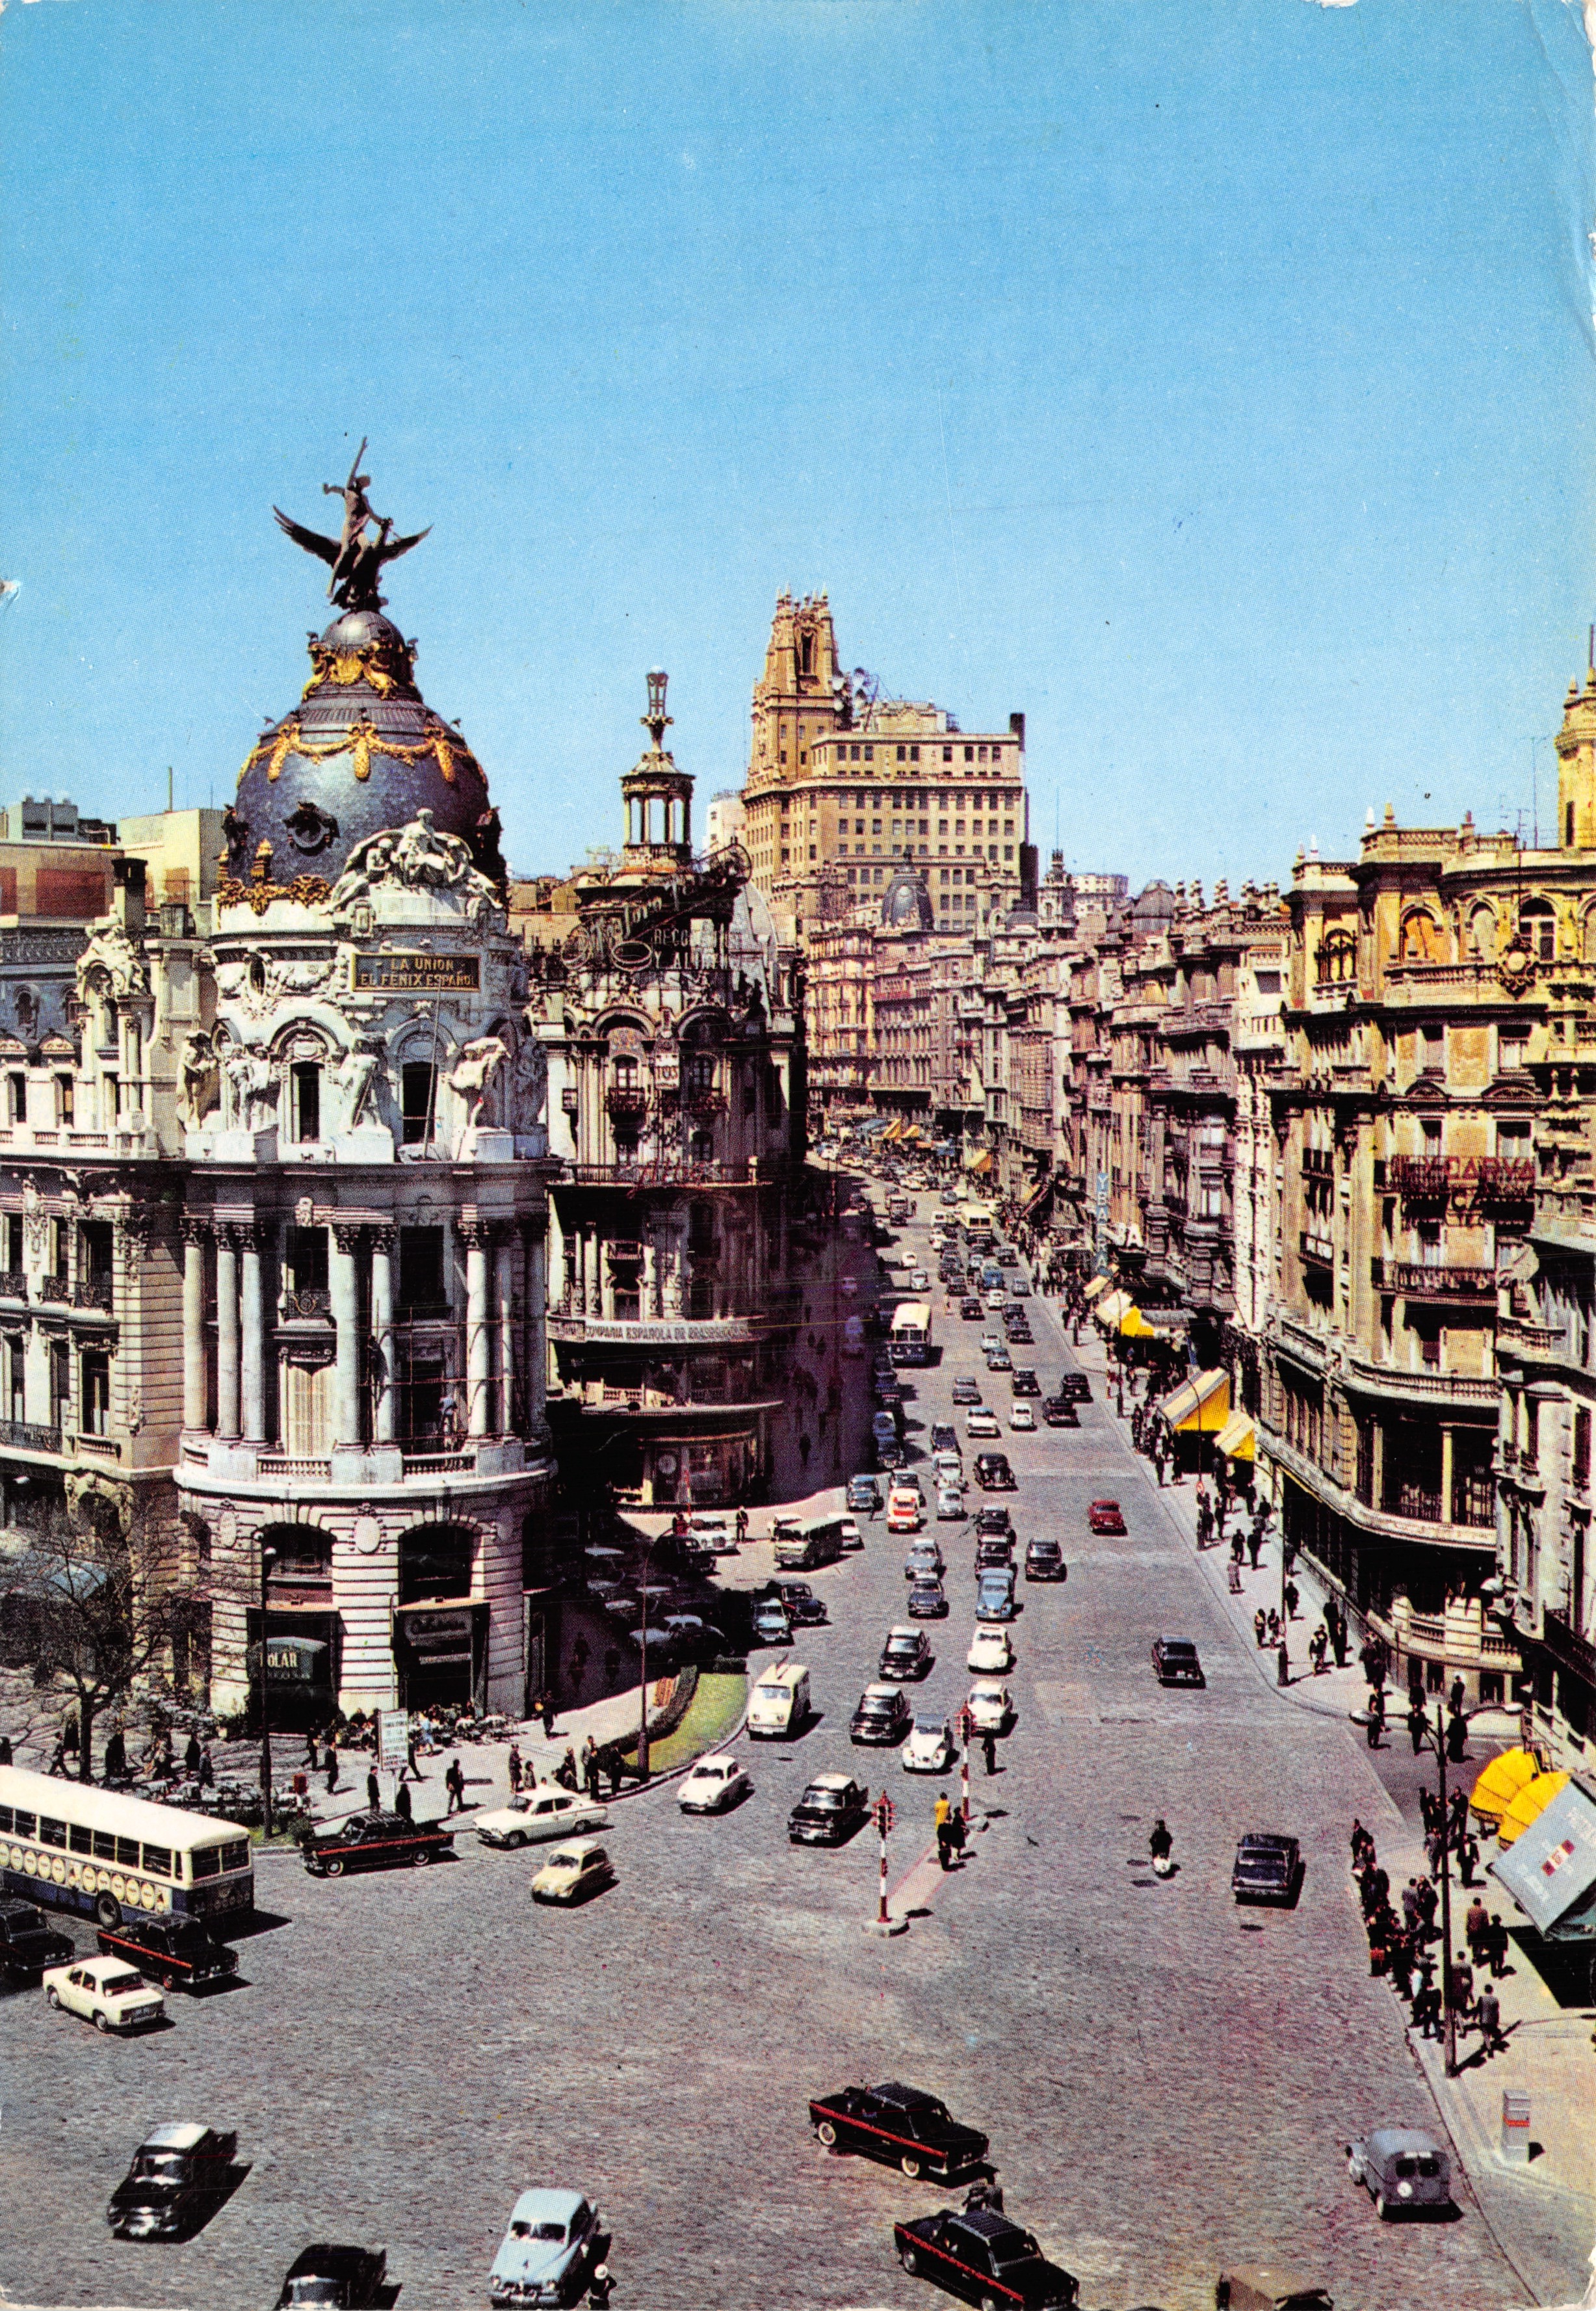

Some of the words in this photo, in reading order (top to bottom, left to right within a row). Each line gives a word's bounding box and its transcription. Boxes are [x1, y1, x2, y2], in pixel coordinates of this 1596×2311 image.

[390, 958, 409, 970] LA
[414, 957, 454, 970] UNION
[360, 974, 376, 986] EL
[426, 971, 476, 986] ESPAÑOL
